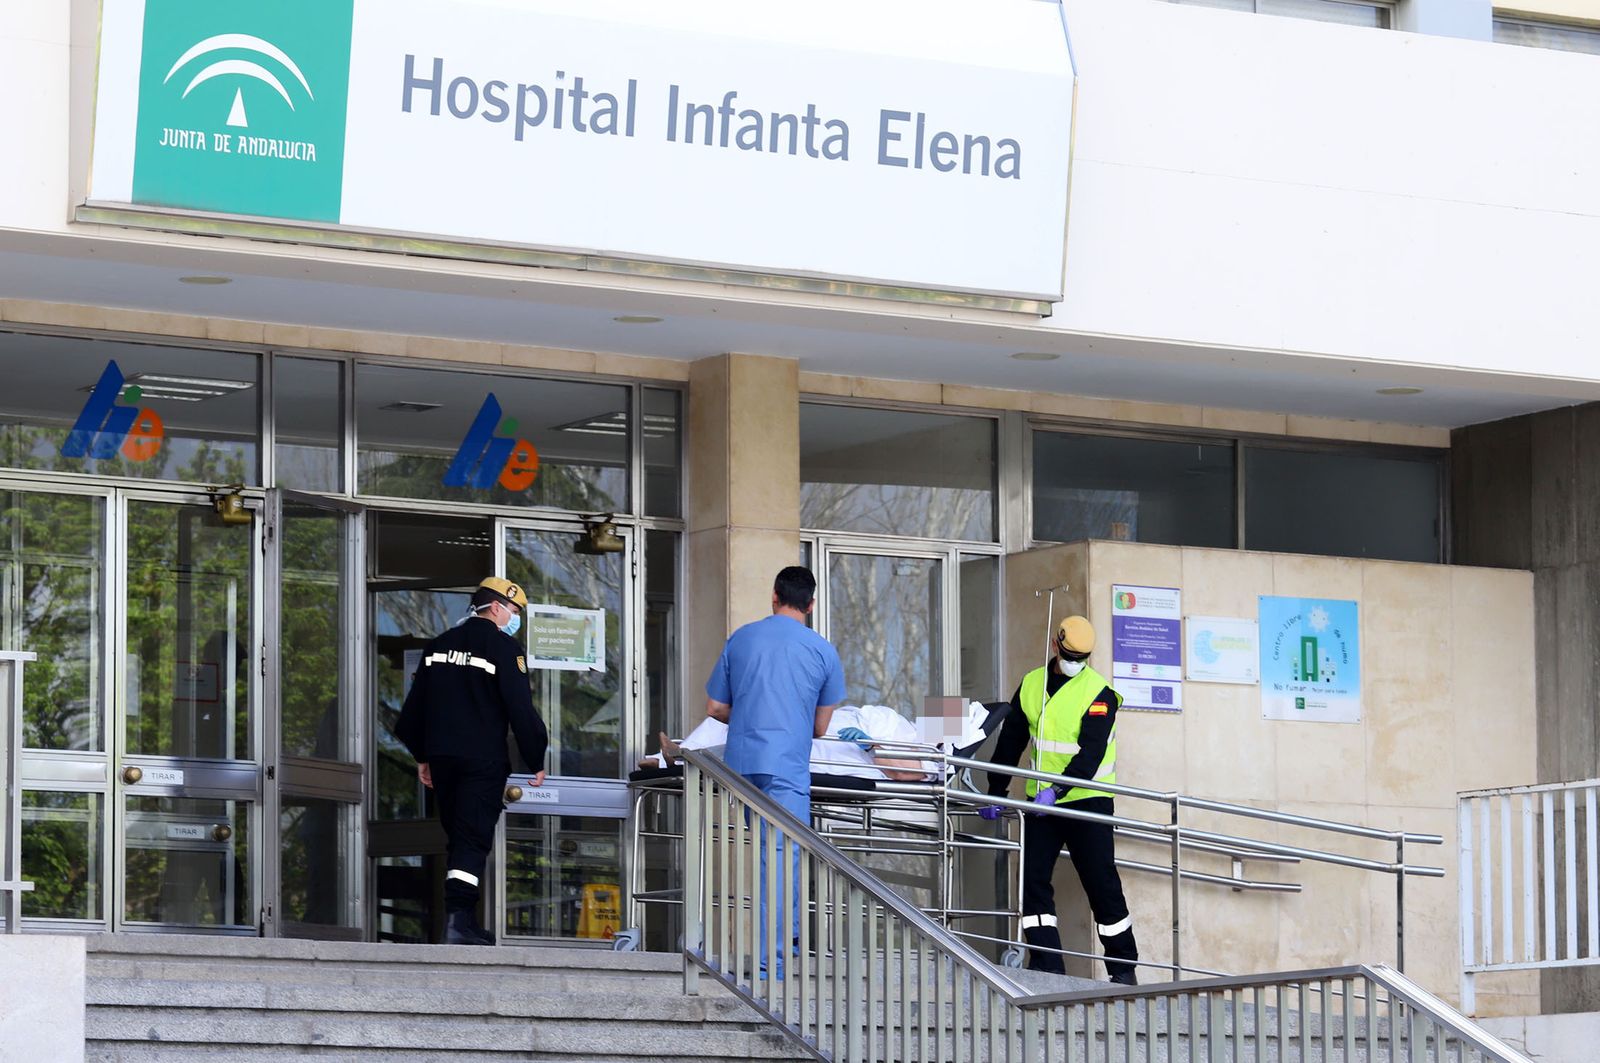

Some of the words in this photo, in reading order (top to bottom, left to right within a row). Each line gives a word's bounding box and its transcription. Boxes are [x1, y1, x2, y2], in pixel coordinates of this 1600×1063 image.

[402, 53, 637, 142] Hospital
[666, 84, 850, 162] Infanta
[877, 108, 1022, 180] Elena
[159, 127, 206, 150] JUNTA
[213, 133, 232, 153] DE
[238, 135, 316, 162] ANDALUCIA
[1282, 614, 1301, 630] libre
[557, 627, 579, 635] familiar
[538, 637, 549, 645] por
[549, 637, 575, 645] paciente
[1273, 682, 1283, 691] No
[1286, 683, 1306, 692] fumar
[151, 772, 175, 781] TIRAR
[528, 791, 552, 799] TIRAR
[174, 827, 198, 835] TIRAR
